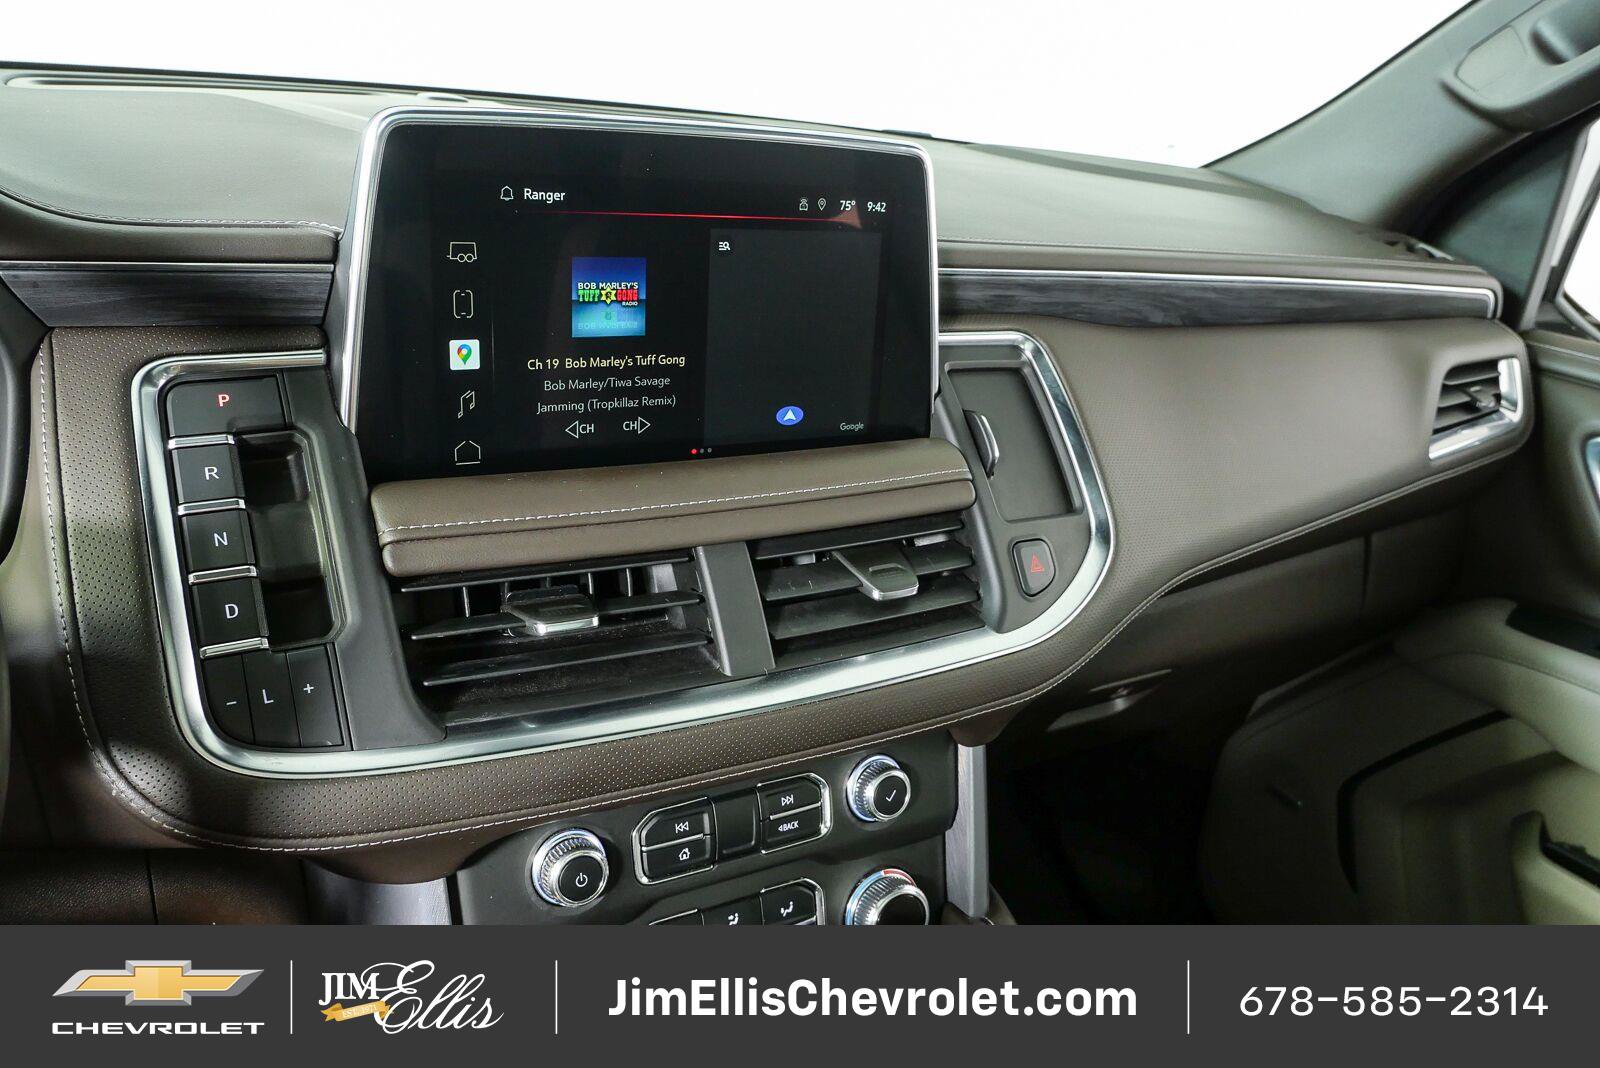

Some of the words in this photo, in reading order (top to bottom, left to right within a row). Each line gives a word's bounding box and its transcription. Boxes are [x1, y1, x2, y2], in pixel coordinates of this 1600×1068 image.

[523, 187, 566, 204] Ranger
[866, 201, 887, 213] 9:42
[577, 282, 597, 290] BOB
[578, 289, 600, 302] TUFF
[617, 289, 638, 302] GONG
[527, 359, 543, 370] Ch
[546, 358, 560, 370] 19
[565, 357, 587, 369] Bob
[589, 355, 634, 370] Marley's
[635, 354, 657, 366] Tuff
[658, 355, 686, 367] Gong
[544, 380, 566, 391] Bob
[568, 376, 632, 391] Marley/Tiwa
[634, 376, 671, 389] Savage
[217, 394, 230, 407] P
[536, 402, 585, 415] Jamming
[587, 397, 639, 413] (Tropkillaz
[641, 394, 677, 408] Remix)
[579, 423, 595, 434] CH
[622, 420, 638, 431] CH
[839, 421, 865, 432] Google
[204, 466, 220, 481] R
[213, 531, 229, 547] N
[224, 603, 239, 619] D
[262, 689, 274, 705] L
[783, 821, 799, 831] BACK
